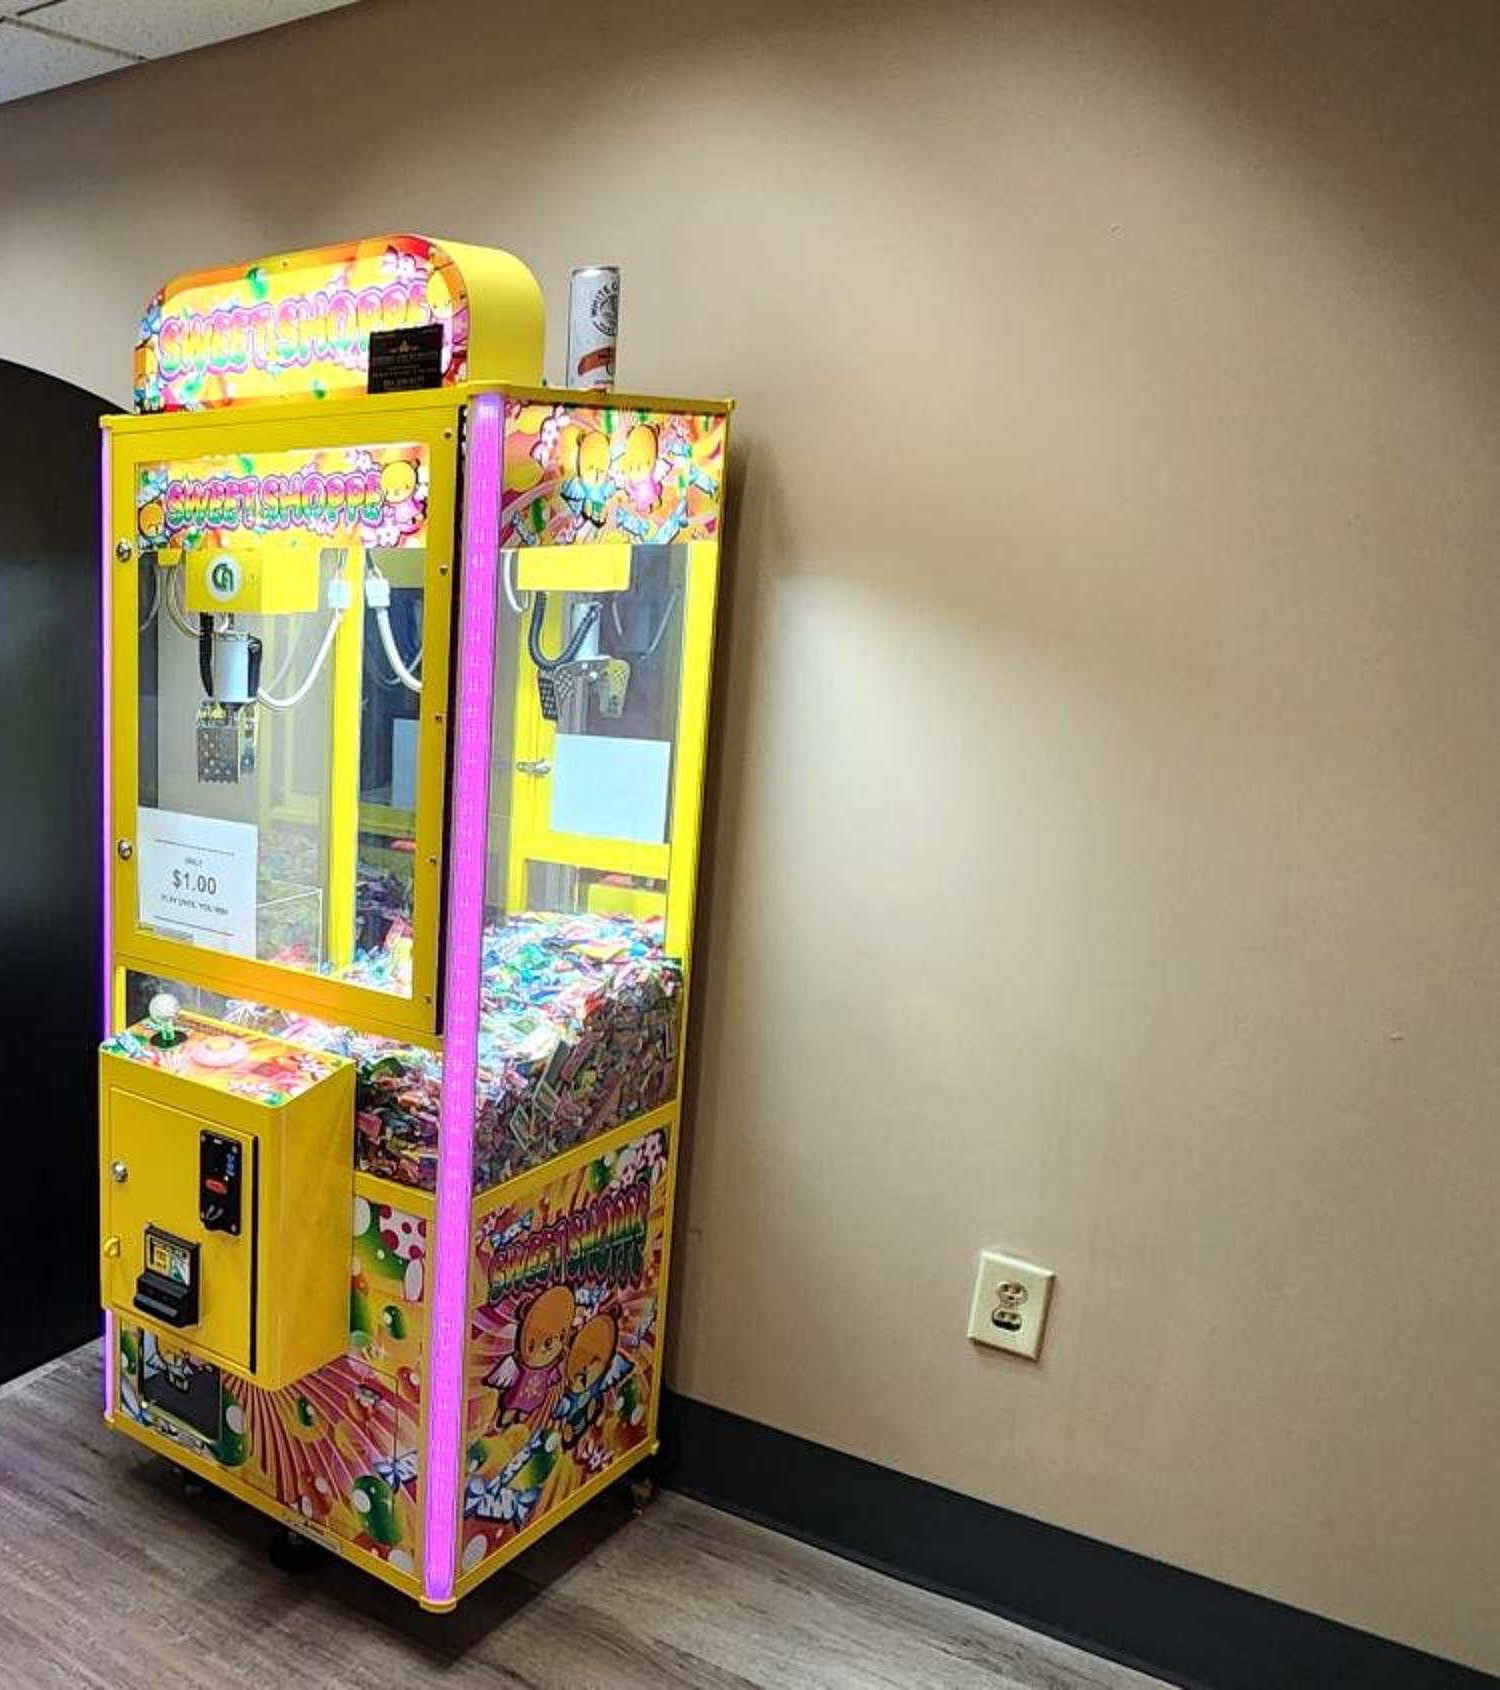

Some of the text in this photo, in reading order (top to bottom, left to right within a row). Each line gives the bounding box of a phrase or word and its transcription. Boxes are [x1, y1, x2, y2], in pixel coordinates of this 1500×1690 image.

[160, 302, 275, 382] SWEET
[165, 470, 386, 531] SWEET SHOPPE
[172, 868, 217, 895] $1.00
[488, 1216, 568, 1304] SWEET
